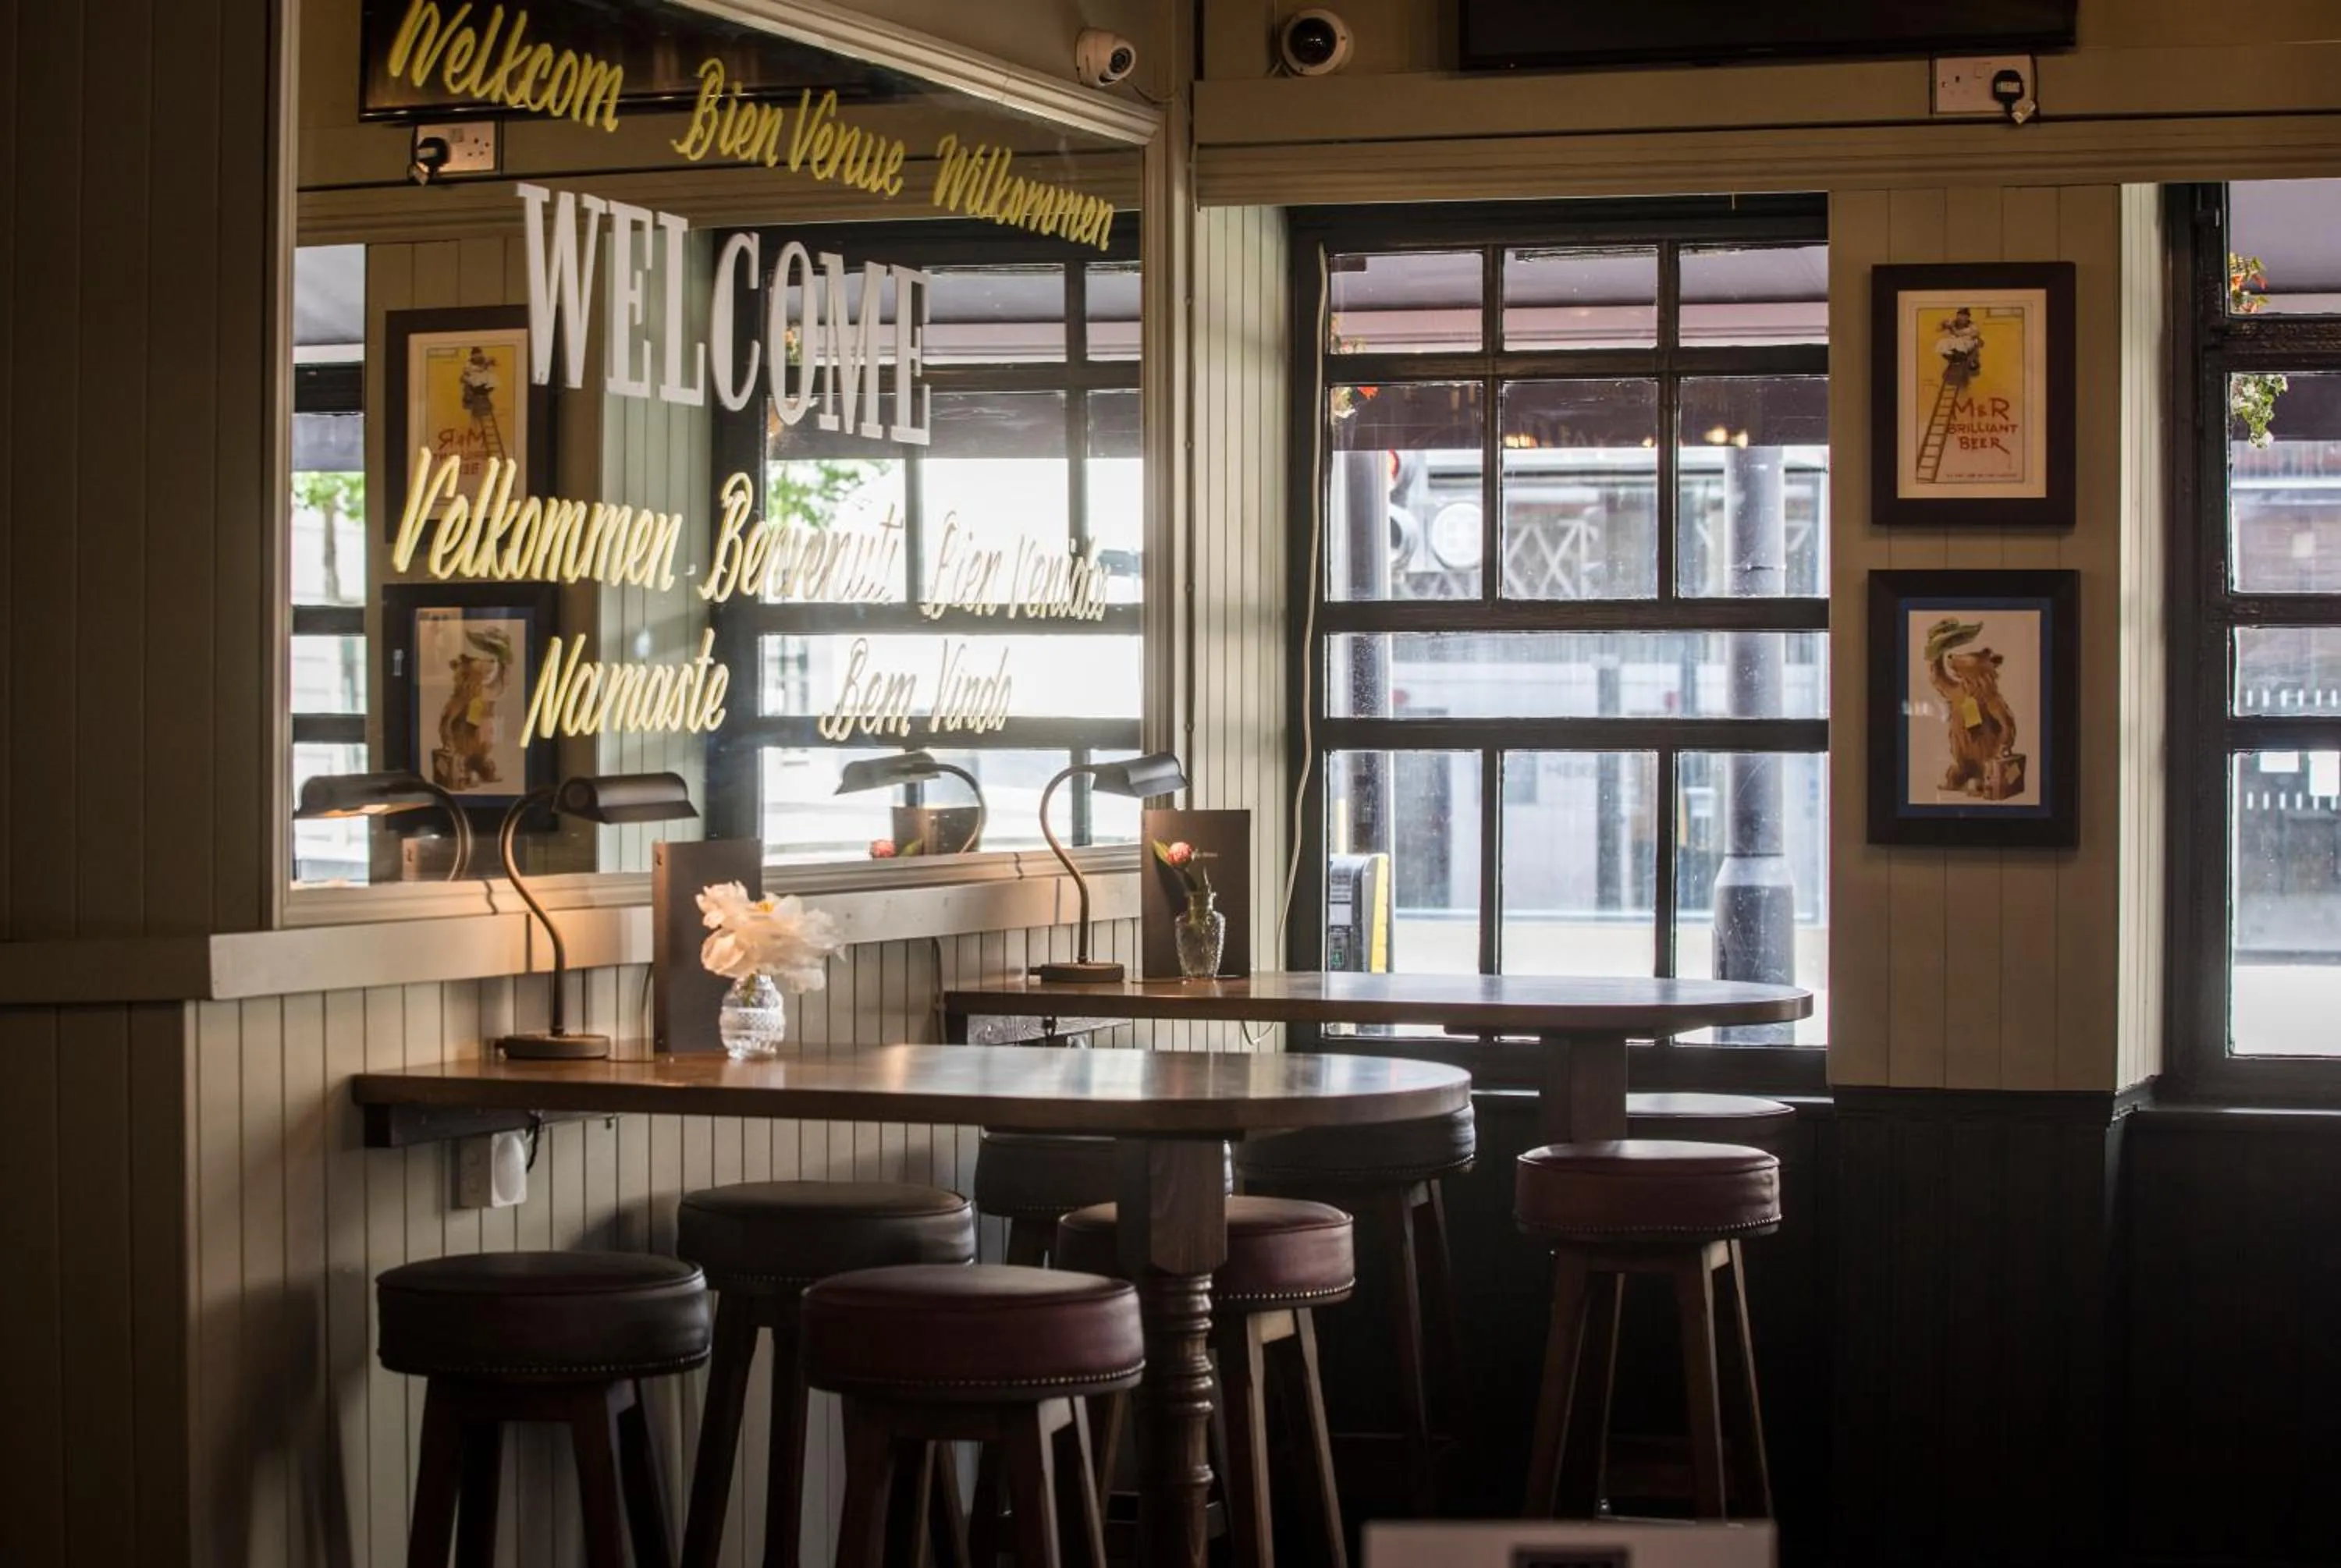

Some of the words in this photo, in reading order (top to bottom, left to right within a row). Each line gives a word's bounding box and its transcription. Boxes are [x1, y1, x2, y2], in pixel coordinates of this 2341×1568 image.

[670, 58, 783, 168] Bien
[788, 87, 905, 197] Venue
[517, 183, 931, 446] WELCOME
[1947, 423, 2019, 435] BRILLIANT
[1959, 436, 2011, 455] BEER
[393, 446, 683, 591] Velkommen
[520, 627, 730, 748] Namaste
[819, 637, 917, 741] Bem
[929, 638, 1012, 734] Vindo
